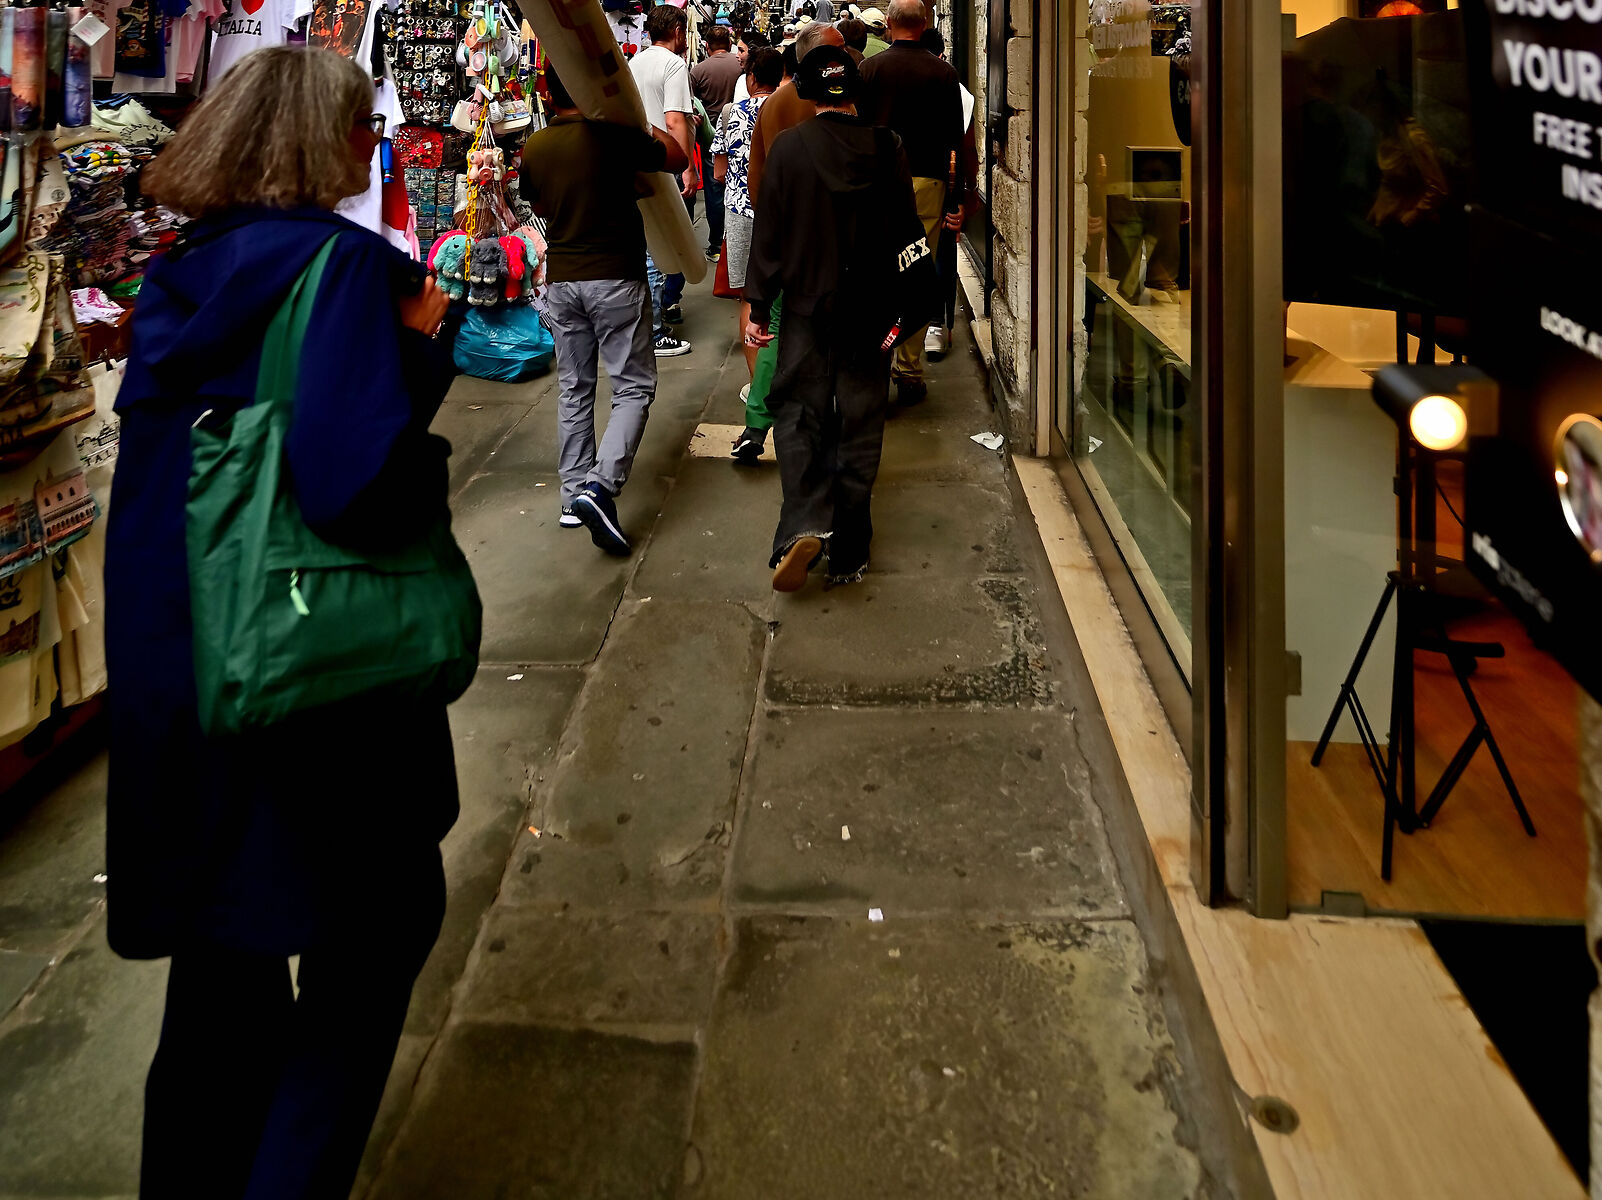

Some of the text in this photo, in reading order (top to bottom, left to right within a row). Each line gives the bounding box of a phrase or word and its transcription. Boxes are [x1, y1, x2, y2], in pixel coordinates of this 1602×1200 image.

[217, 19, 263, 37] ITALIA
[1503, 39, 1602, 104] YOUR
[1534, 111, 1594, 159] FREE
